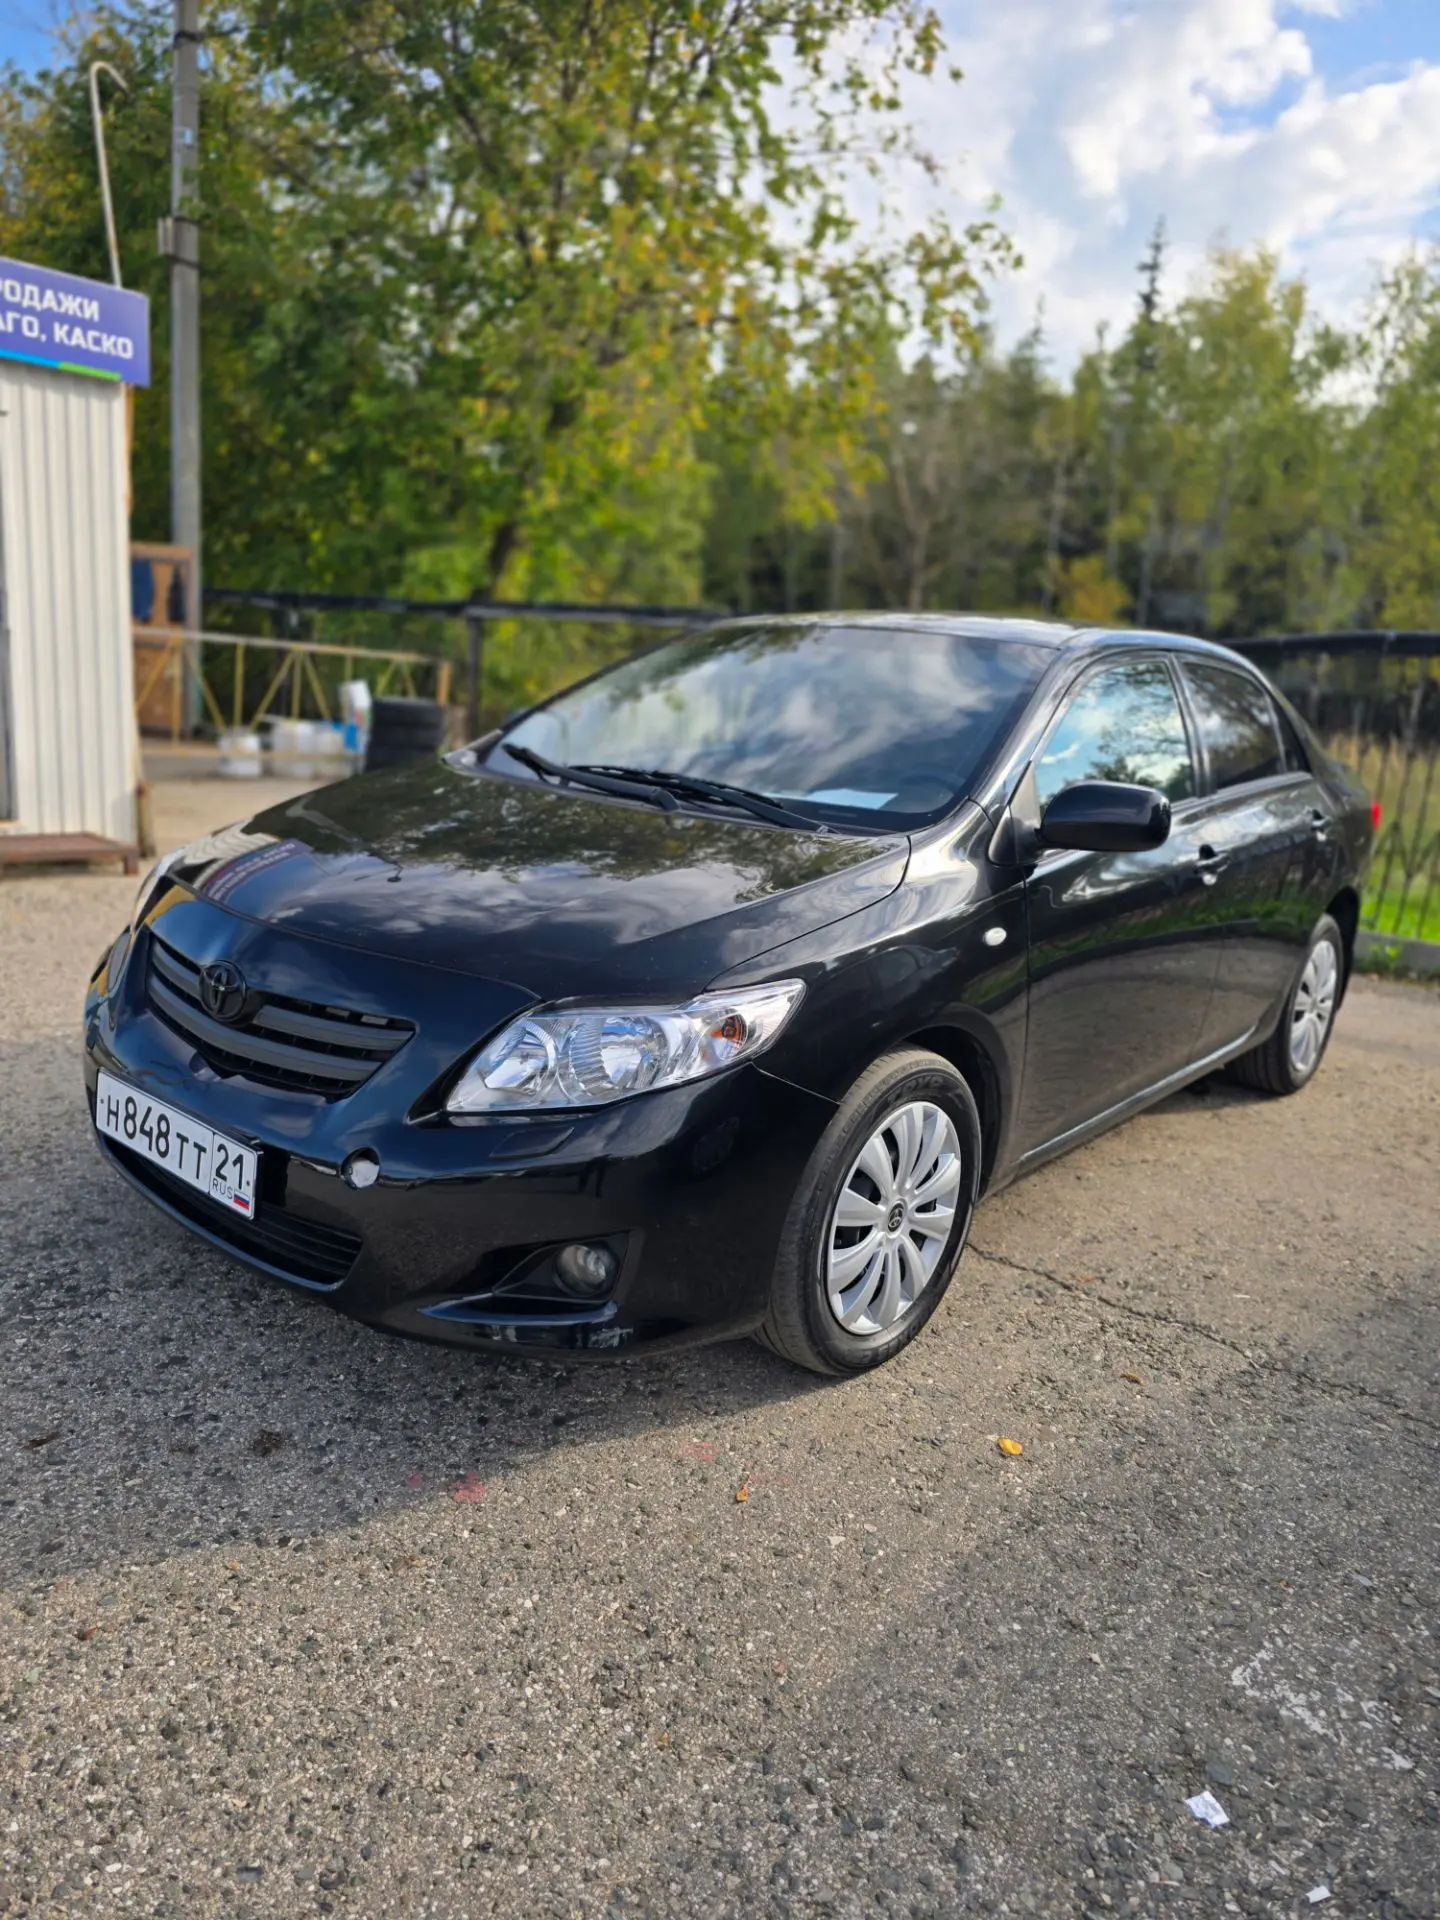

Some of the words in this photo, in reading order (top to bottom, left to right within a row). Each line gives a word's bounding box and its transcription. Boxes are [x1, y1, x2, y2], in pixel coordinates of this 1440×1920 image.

[0, 277, 100, 322] ОДАЖИ
[53, 321, 134, 360] КАСКО
[215, 1143, 244, 1190] 21
[212, 1179, 233, 1200] RUS
